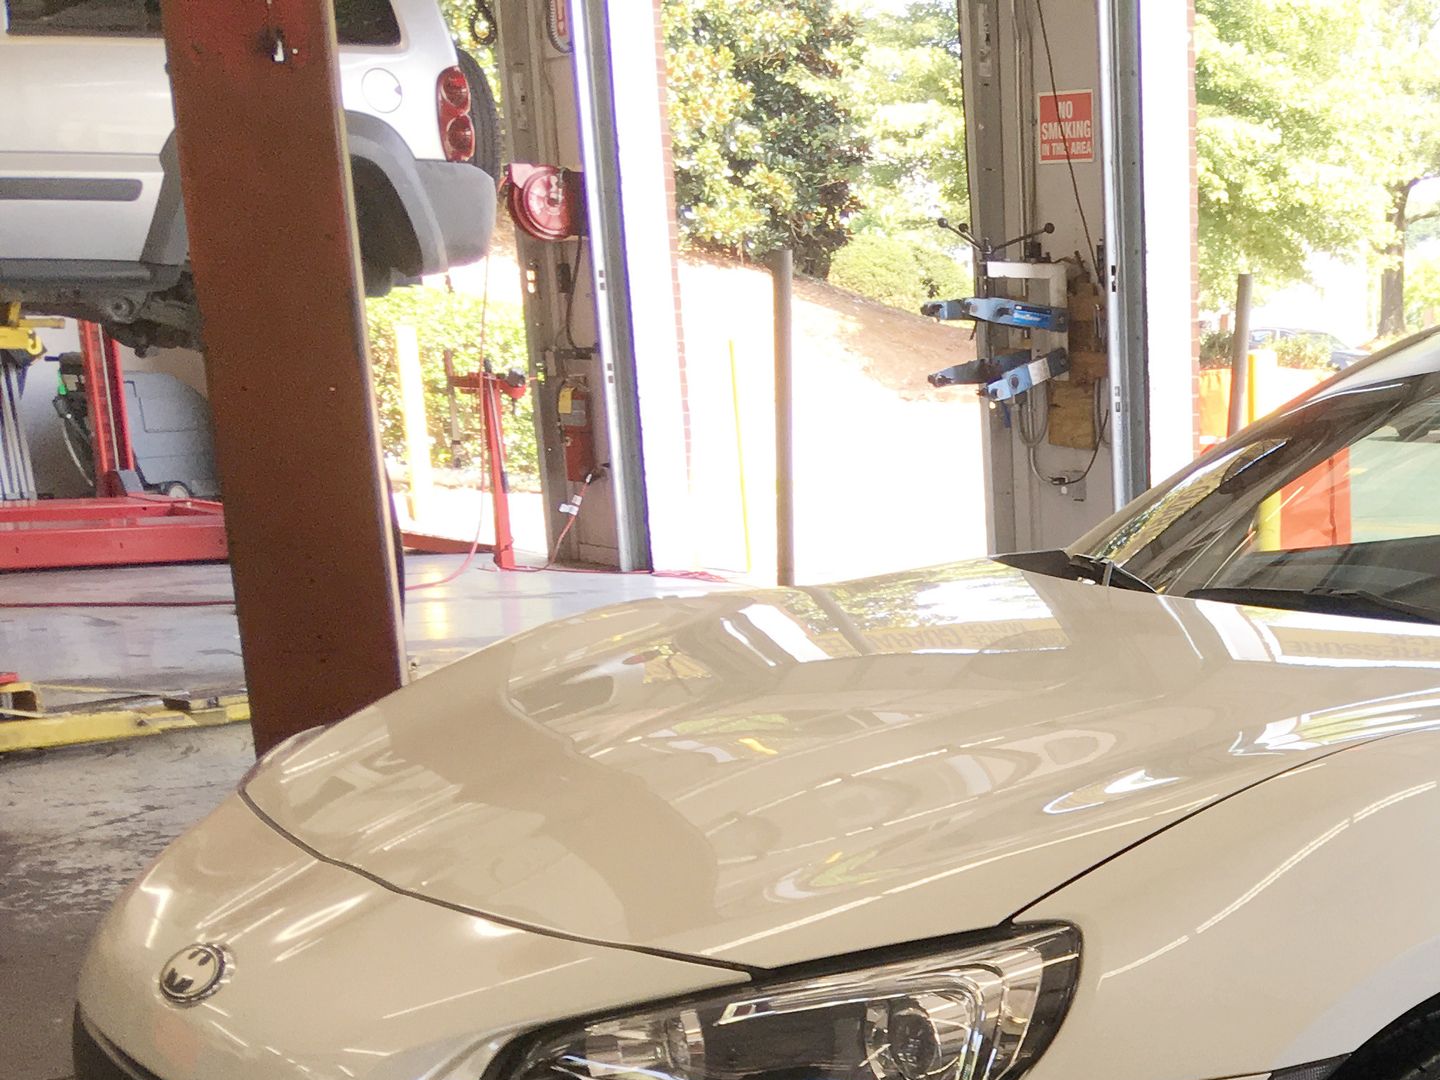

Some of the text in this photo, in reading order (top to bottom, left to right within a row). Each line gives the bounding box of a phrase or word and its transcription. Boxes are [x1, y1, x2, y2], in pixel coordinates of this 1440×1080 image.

[1057, 101, 1073, 119] NO
[1041, 120, 1091, 140] SMOKING
[1041, 143, 1050, 156] IN
[1071, 141, 1091, 155] AREA
